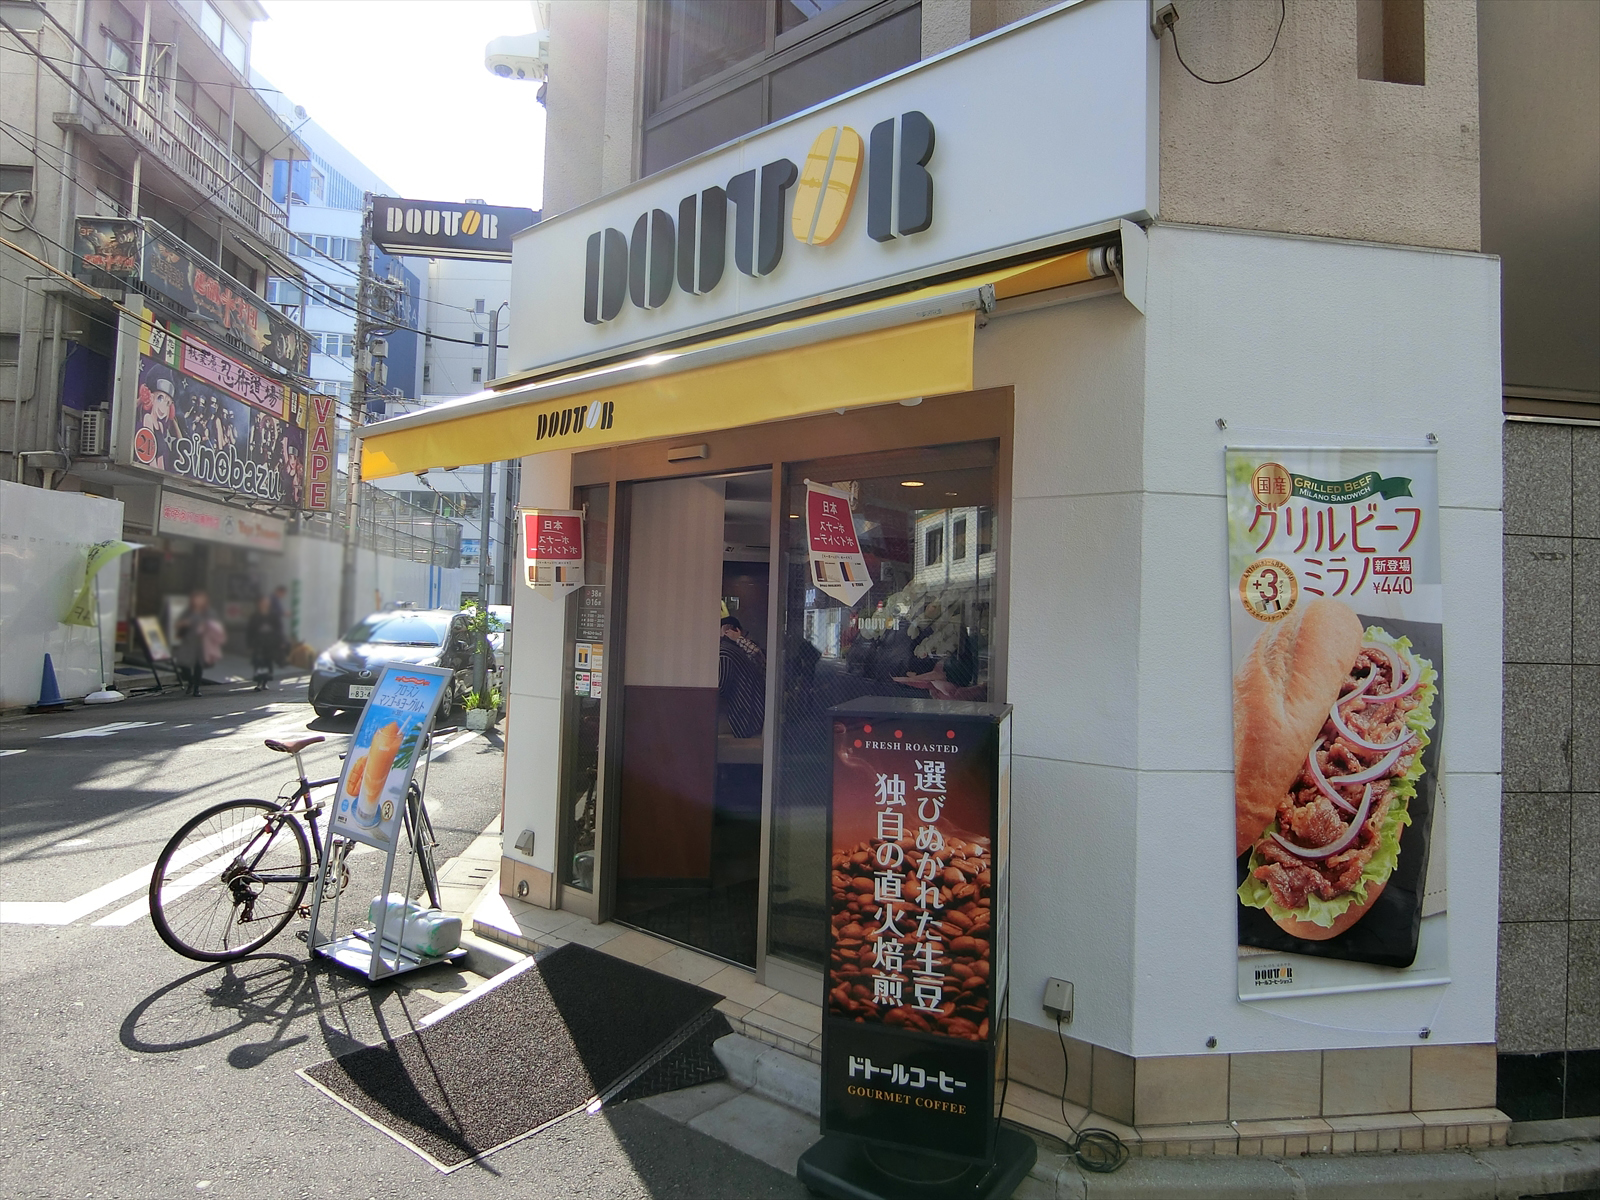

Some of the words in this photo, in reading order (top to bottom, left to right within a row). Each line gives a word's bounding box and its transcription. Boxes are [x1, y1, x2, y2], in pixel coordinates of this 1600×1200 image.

[387, 207, 498, 239] DOUTOR
[584, 111, 935, 325] DOUTOR
[536, 400, 614, 440] DOUTOR
[174, 433, 281, 501] sinobazu
[310, 398, 332, 509] VAPE
[1257, 476, 1287, 495] 国産
[1294, 477, 1342, 494] GRILLED
[1344, 475, 1373, 492] BEEF
[1249, 503, 1421, 553] グリルビーフ
[1303, 556, 1369, 596] ミラノ
[1374, 559, 1411, 573] 新登場
[1373, 576, 1413, 594] ¥440
[858, 617, 900, 631] DOUTOR
[865, 740, 901, 751] FRESH
[905, 742, 959, 754] ROASTED
[872, 773, 906, 1007] 独自の直火焙煎
[912, 759, 947, 1013] 選びぬかれた生豆
[1255, 967, 1292, 980] DOUTOR
[848, 1055, 967, 1093] ドトールコーヒー
[847, 1085, 912, 1105] GOURMET
[915, 1097, 967, 1115] COFFEE
